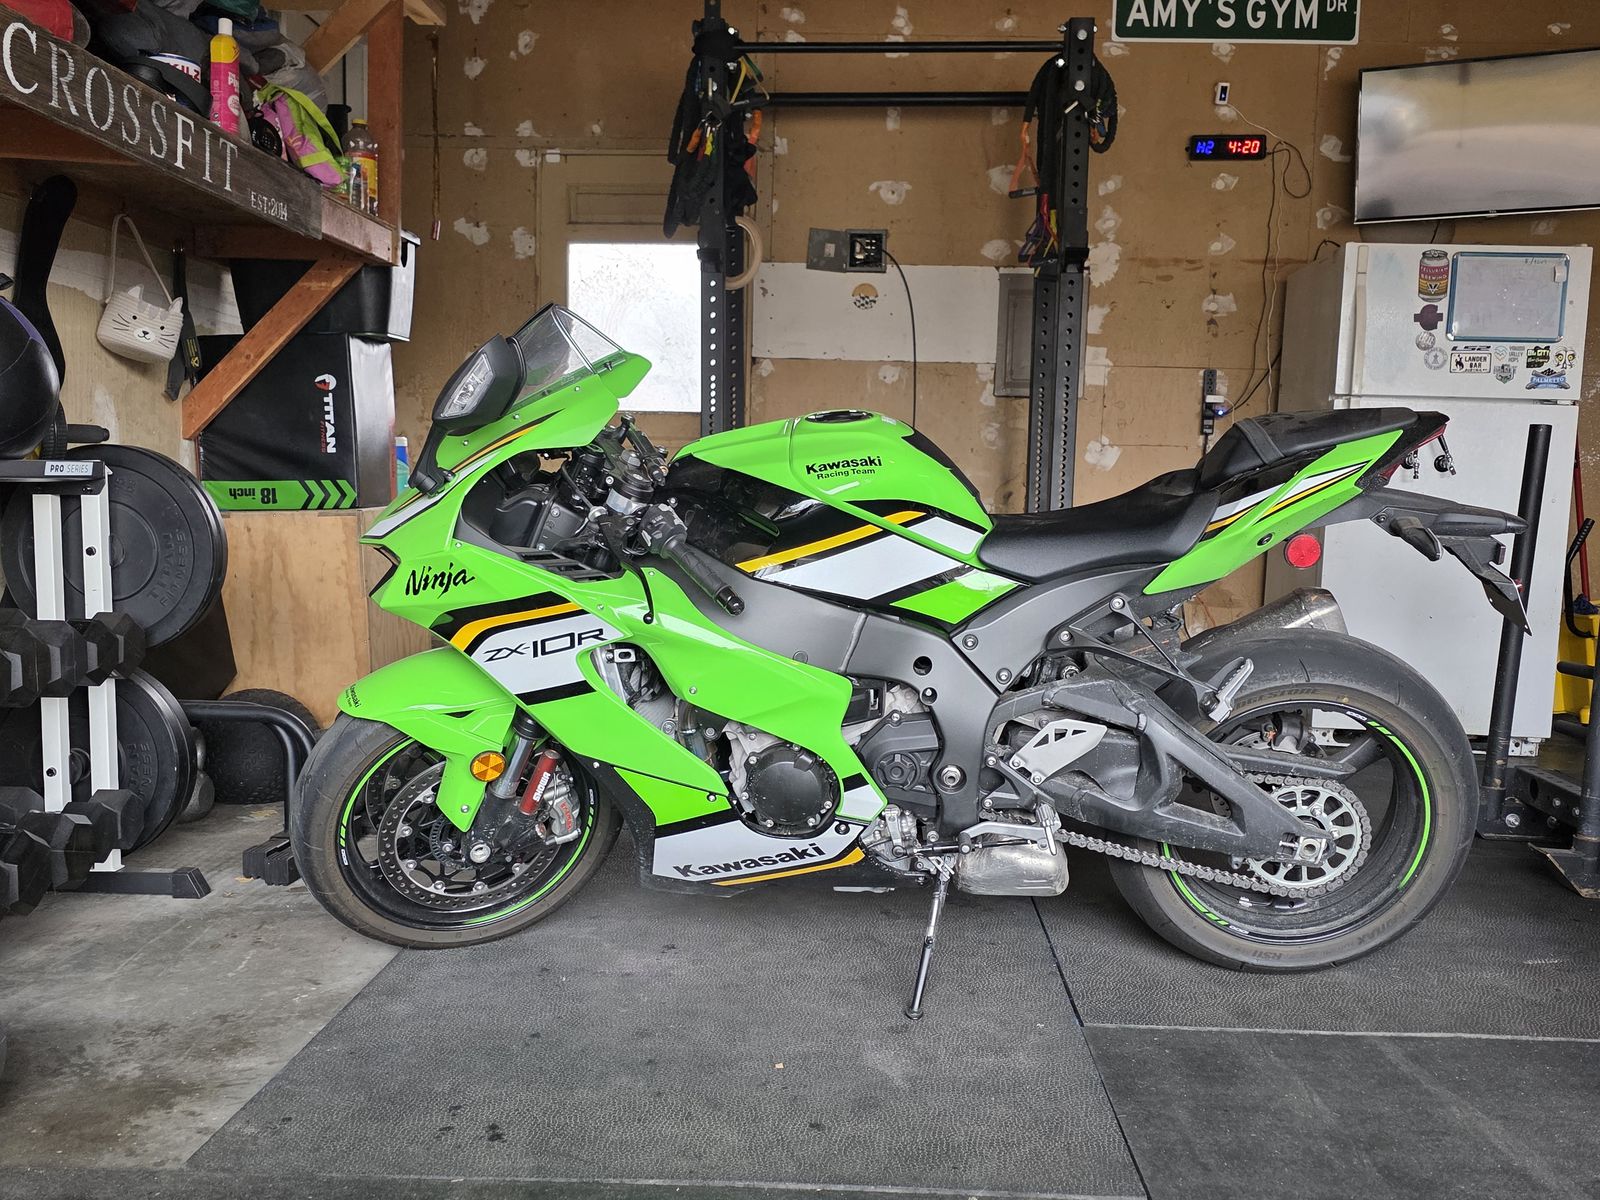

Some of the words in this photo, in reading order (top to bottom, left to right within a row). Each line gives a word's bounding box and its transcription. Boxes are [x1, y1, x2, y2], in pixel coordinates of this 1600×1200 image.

[1126, 0, 1236, 28] AMY'S
[1246, 0, 1318, 29] GYM
[1326, 0, 1348, 13] DR
[3, 22, 238, 192] CROSSFIT
[1228, 140, 1261, 154] 4:20
[323, 392, 337, 453] TITAN
[50, 464, 65, 473] PRO
[66, 464, 89, 473] SERIES
[805, 455, 882, 475] Kawasaki
[816, 470, 850, 480] Racing
[850, 467, 876, 475] Team
[228, 487, 256, 500] inch
[260, 487, 278, 505] 18
[405, 562, 475, 599] Ninja
[483, 628, 608, 663] ZX-10R
[533, 771, 551, 802] SHOWA
[673, 842, 826, 878] Kawasaki
